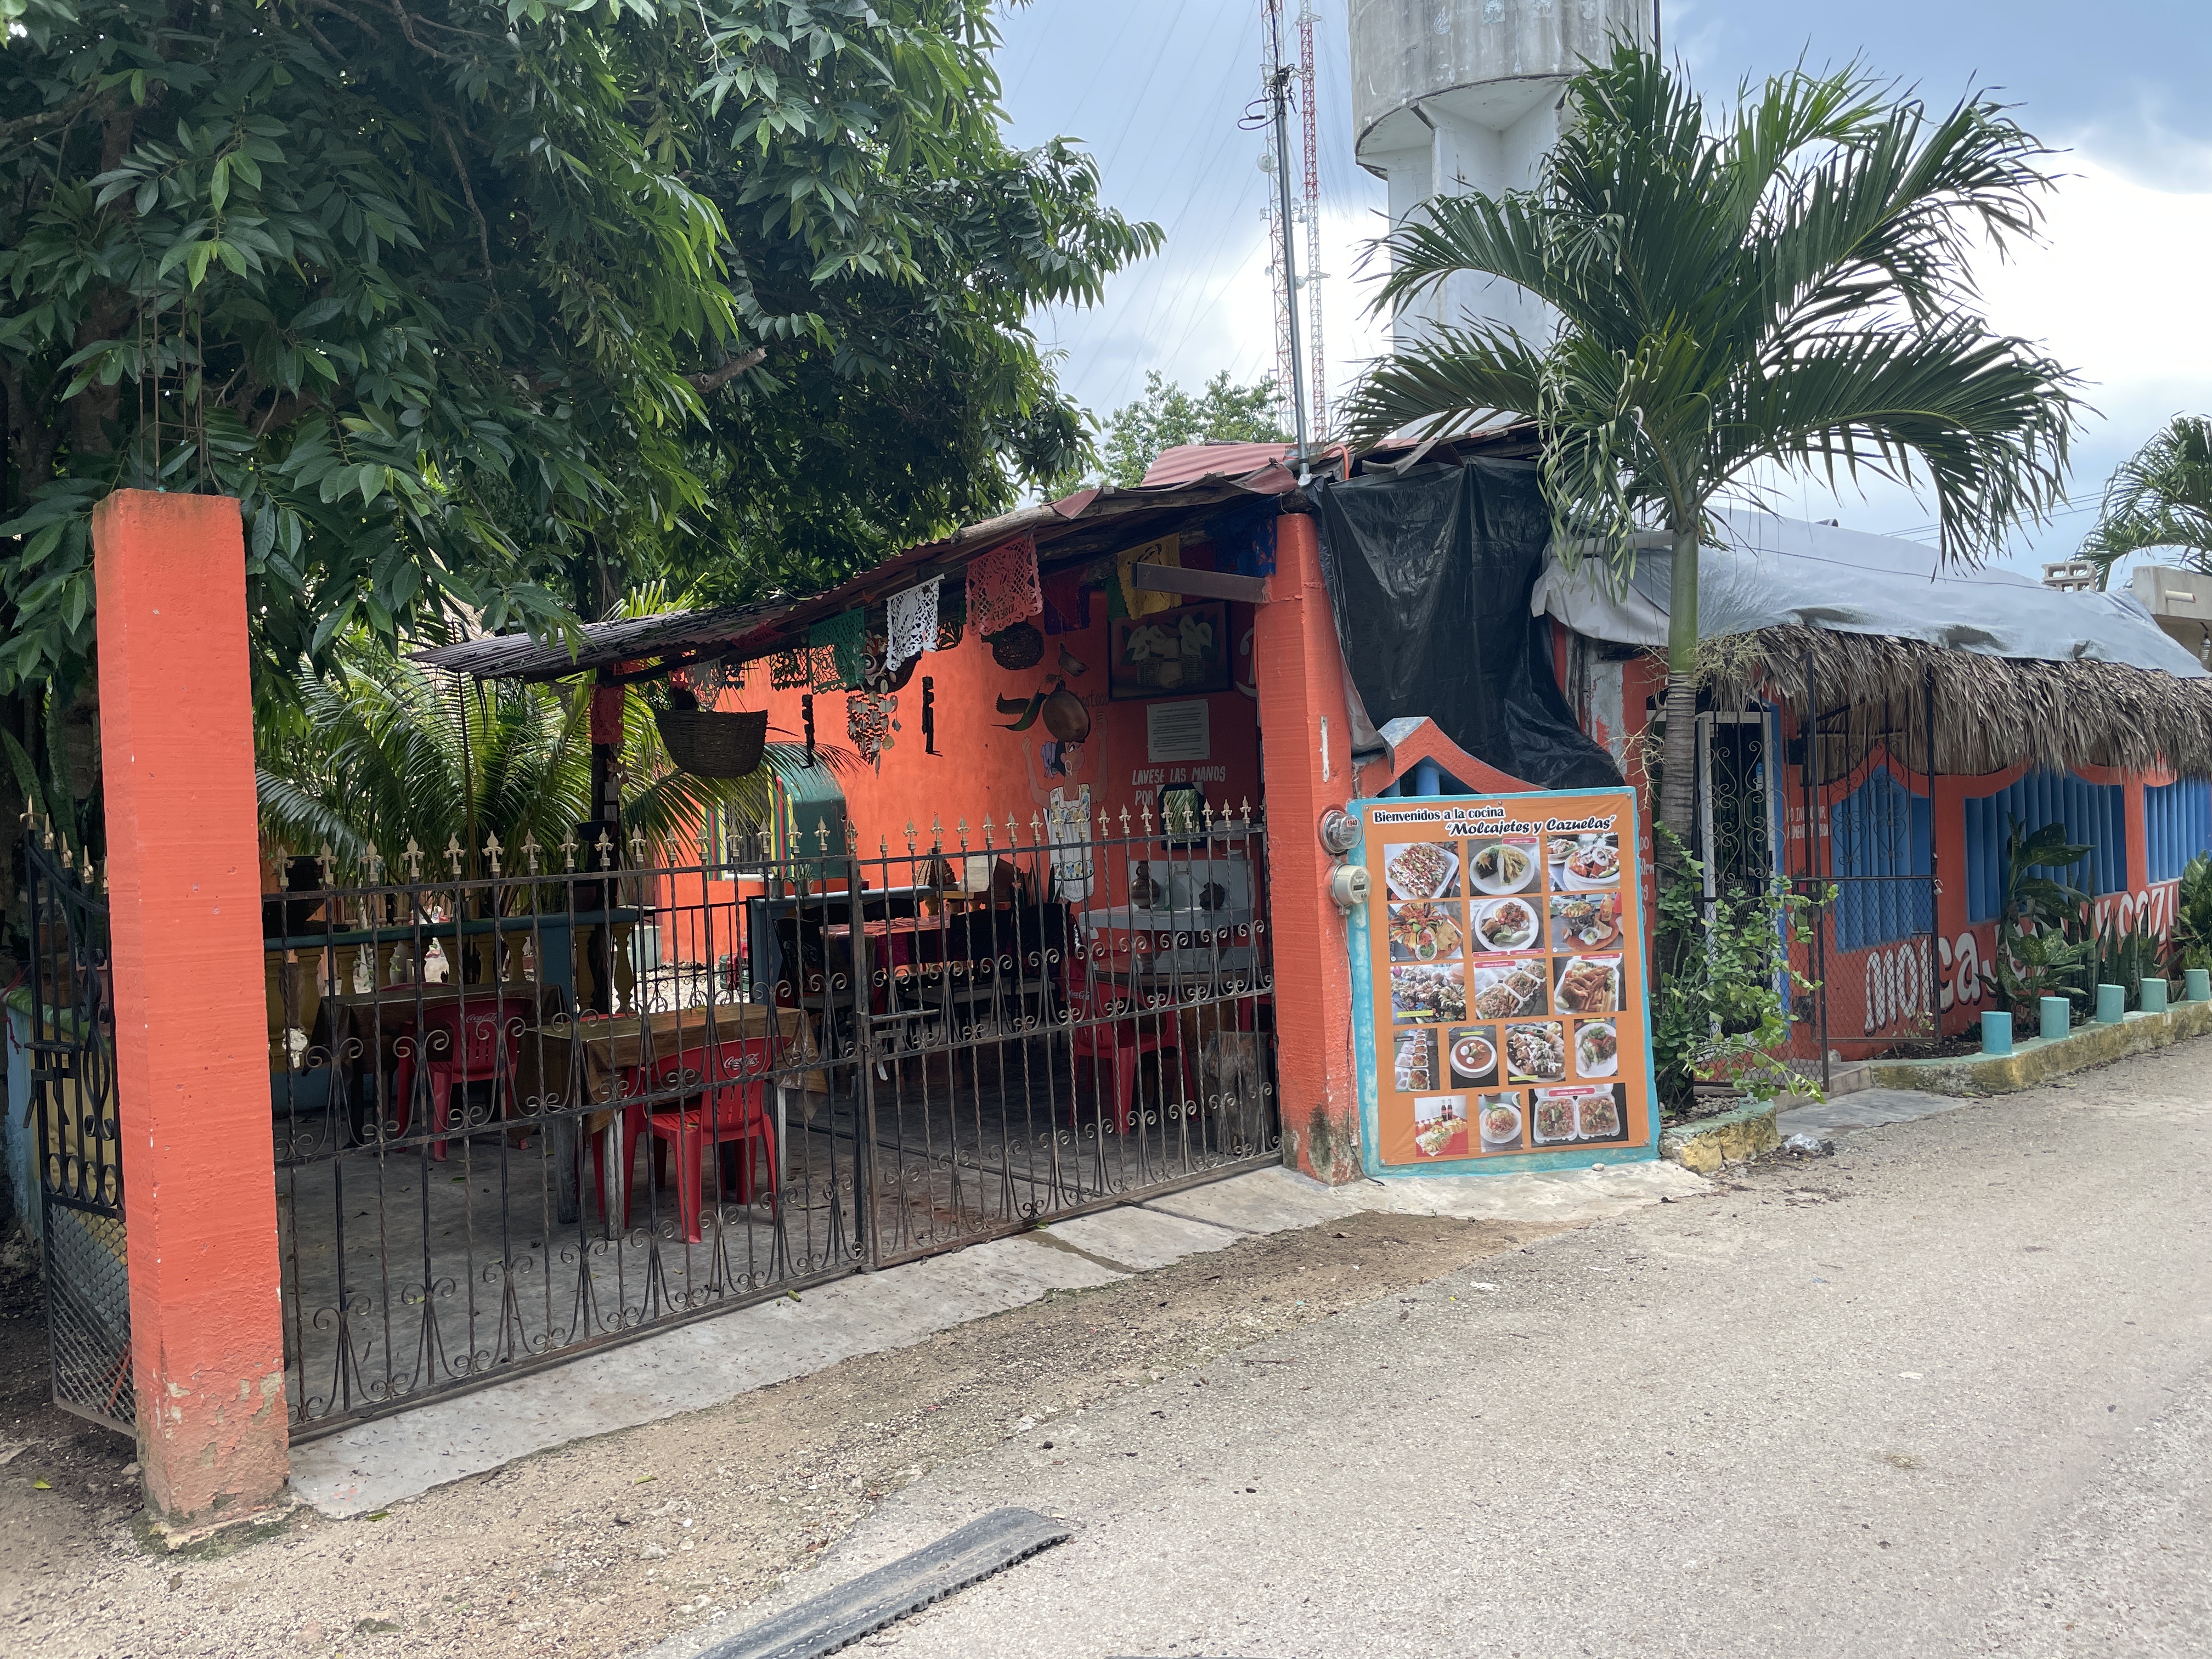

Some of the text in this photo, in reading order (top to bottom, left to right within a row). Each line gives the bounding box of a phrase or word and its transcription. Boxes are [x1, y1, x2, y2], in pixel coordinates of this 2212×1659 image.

[1132, 766, 1226, 786] LAVESE LAS MANOS
[1135, 790, 1154, 806] POR
[1374, 806, 1504, 822] Bienvenidos a la cocina
[1534, 822, 1542, 834] y
